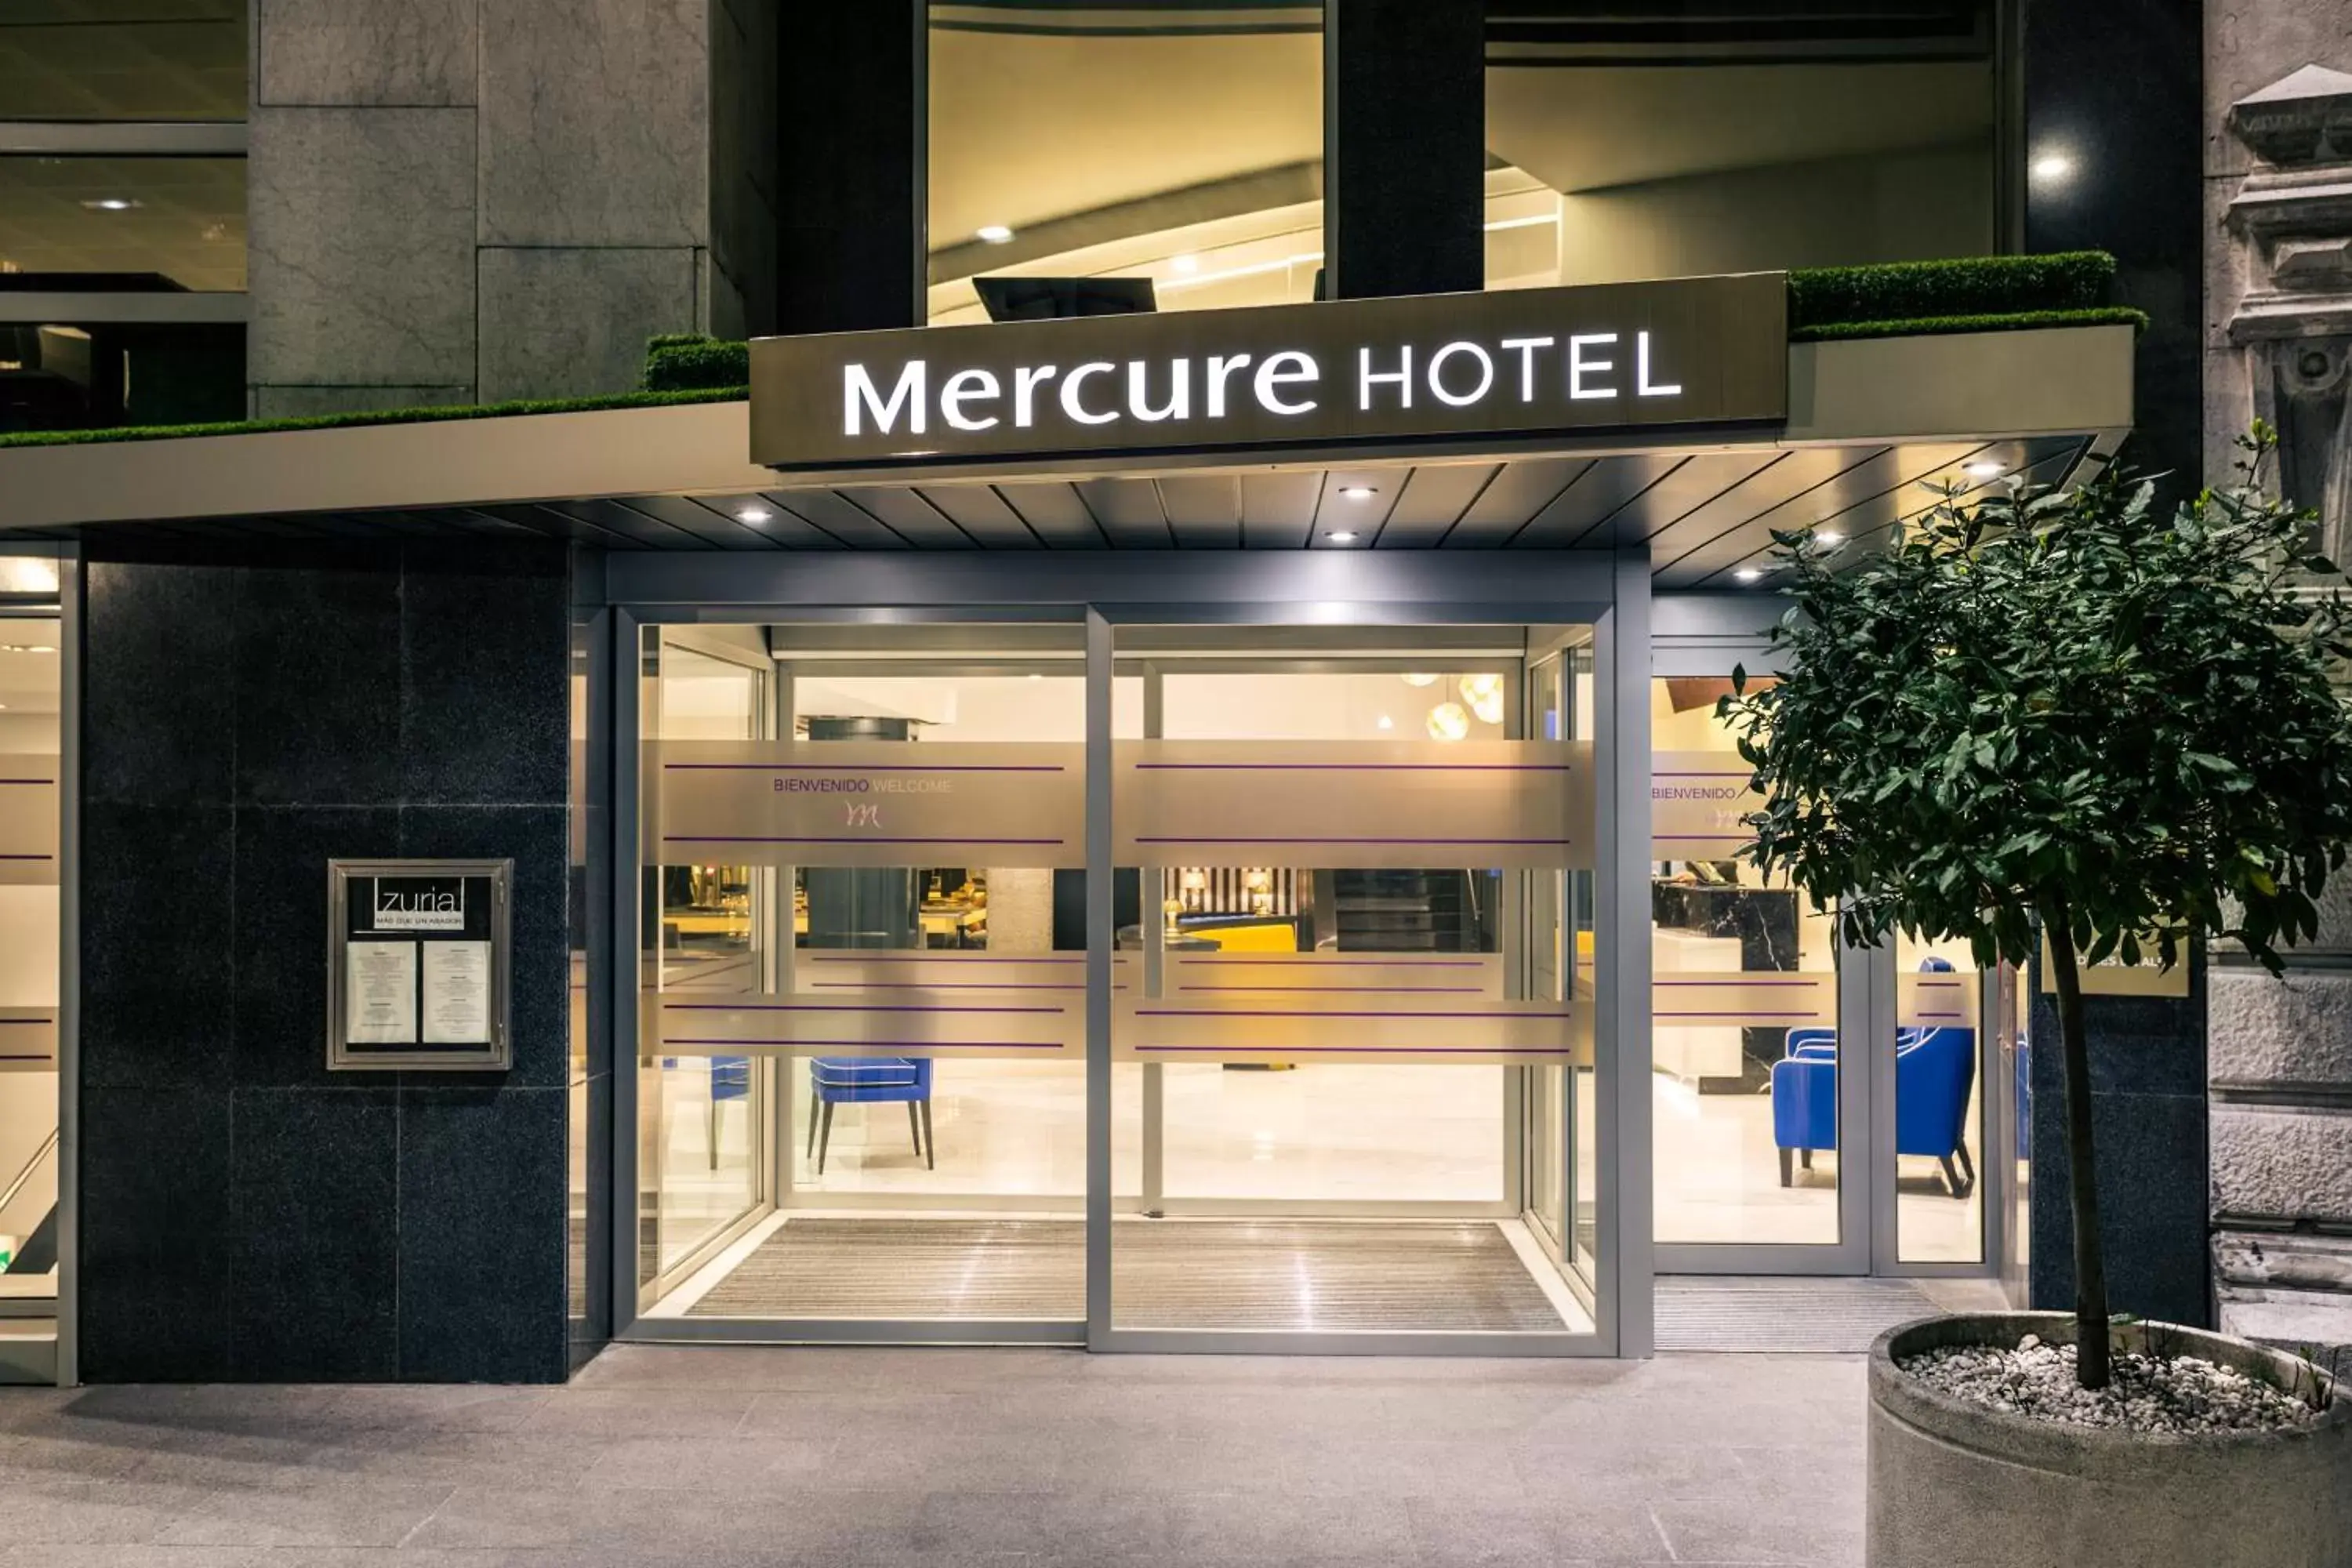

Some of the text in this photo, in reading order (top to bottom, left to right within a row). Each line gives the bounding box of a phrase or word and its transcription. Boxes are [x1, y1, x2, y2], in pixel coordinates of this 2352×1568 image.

[844, 331, 1682, 436] Mercure HOTEL
[774, 779, 953, 793] BIENVENIDO WELCOME
[1652, 787, 1736, 800] BIENVENIDO
[383, 886, 455, 913] zuria
